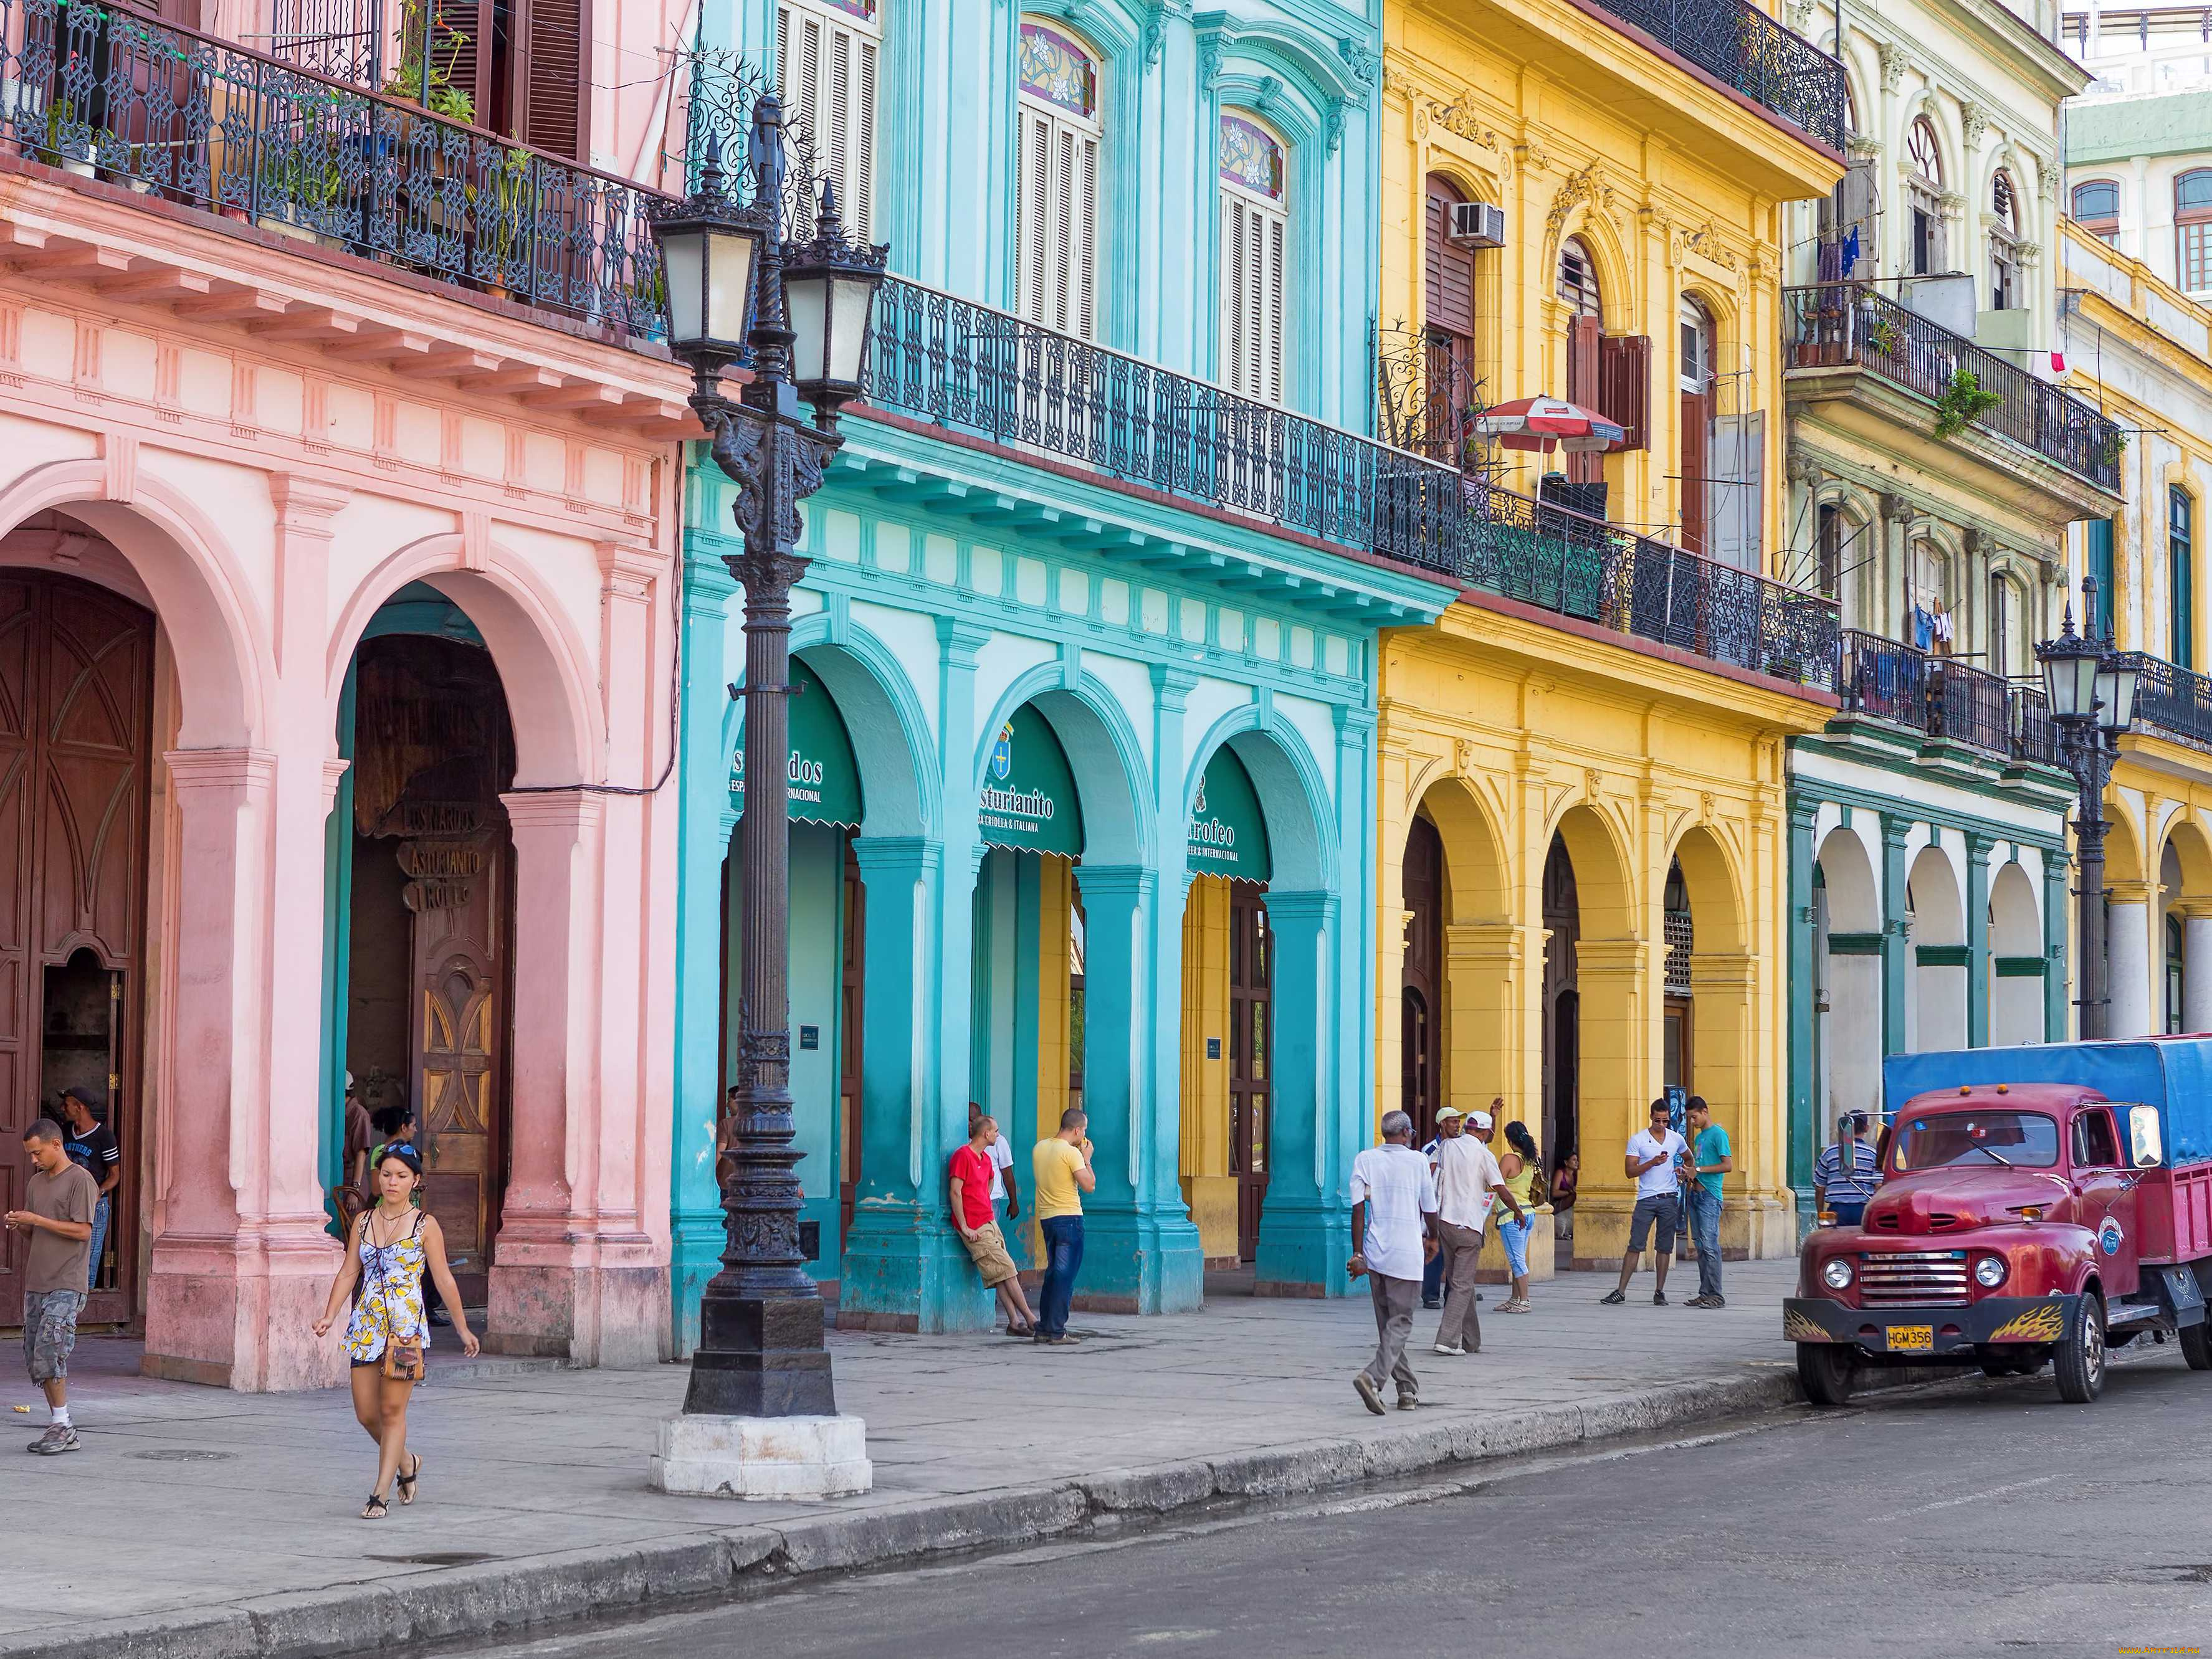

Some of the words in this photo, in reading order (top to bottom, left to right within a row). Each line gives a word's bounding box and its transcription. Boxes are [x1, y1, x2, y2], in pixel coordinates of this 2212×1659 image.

[789, 753, 822, 782] dos
[980, 786, 1053, 817] sturianito
[985, 815, 1008, 829] CRIOLLA
[1008, 819, 1013, 829] &
[1014, 820, 1039, 833] ITALIANA
[410, 847, 479, 875] ASTURIANITO
[1198, 847, 1201, 856] &
[1202, 847, 1239, 862] INTERNACIONAL
[65, 1142, 92, 1157] ANTHERS
[1888, 1331, 1931, 1344] HGM356
